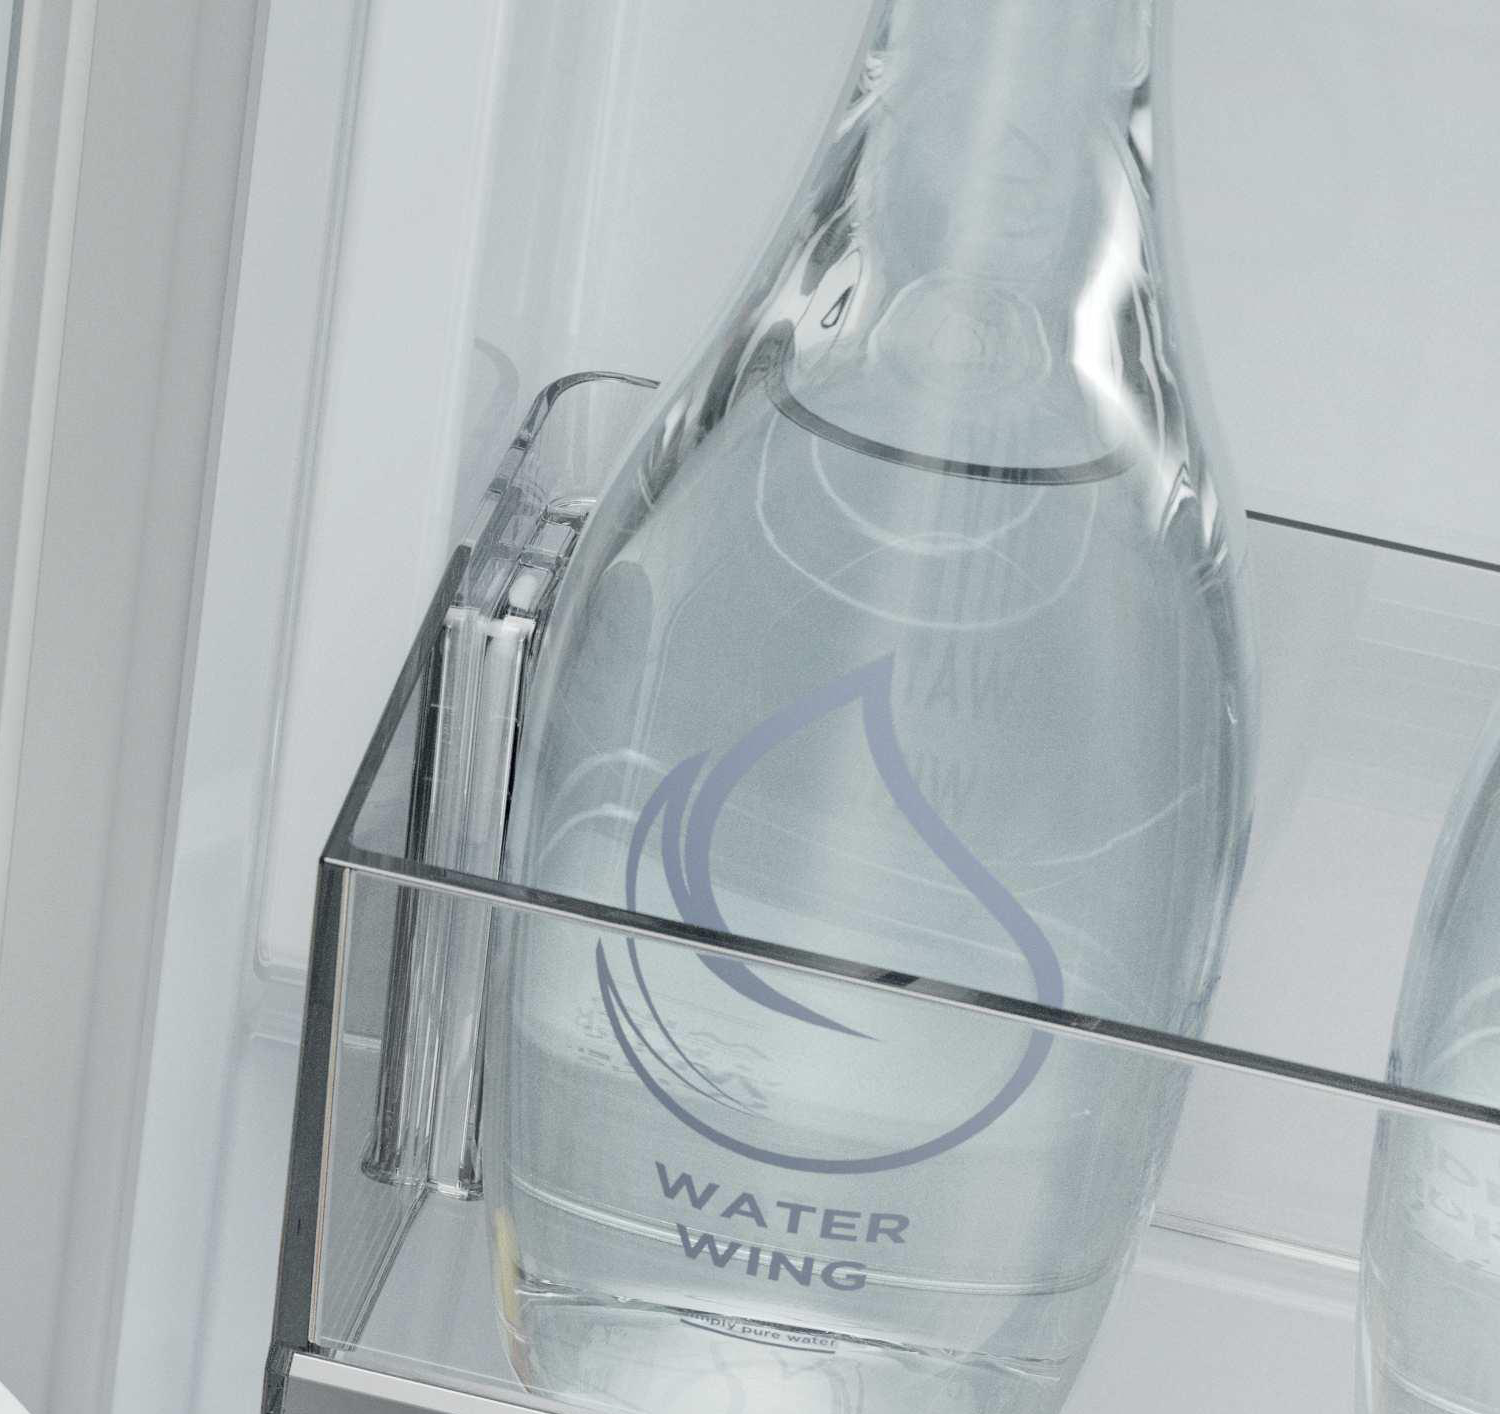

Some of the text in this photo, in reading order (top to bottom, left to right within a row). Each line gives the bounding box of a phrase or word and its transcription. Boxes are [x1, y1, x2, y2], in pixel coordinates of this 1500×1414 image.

[655, 1160, 910, 1244] WATER
[676, 1223, 868, 1292] WING
[742, 1325, 781, 1340] pure
